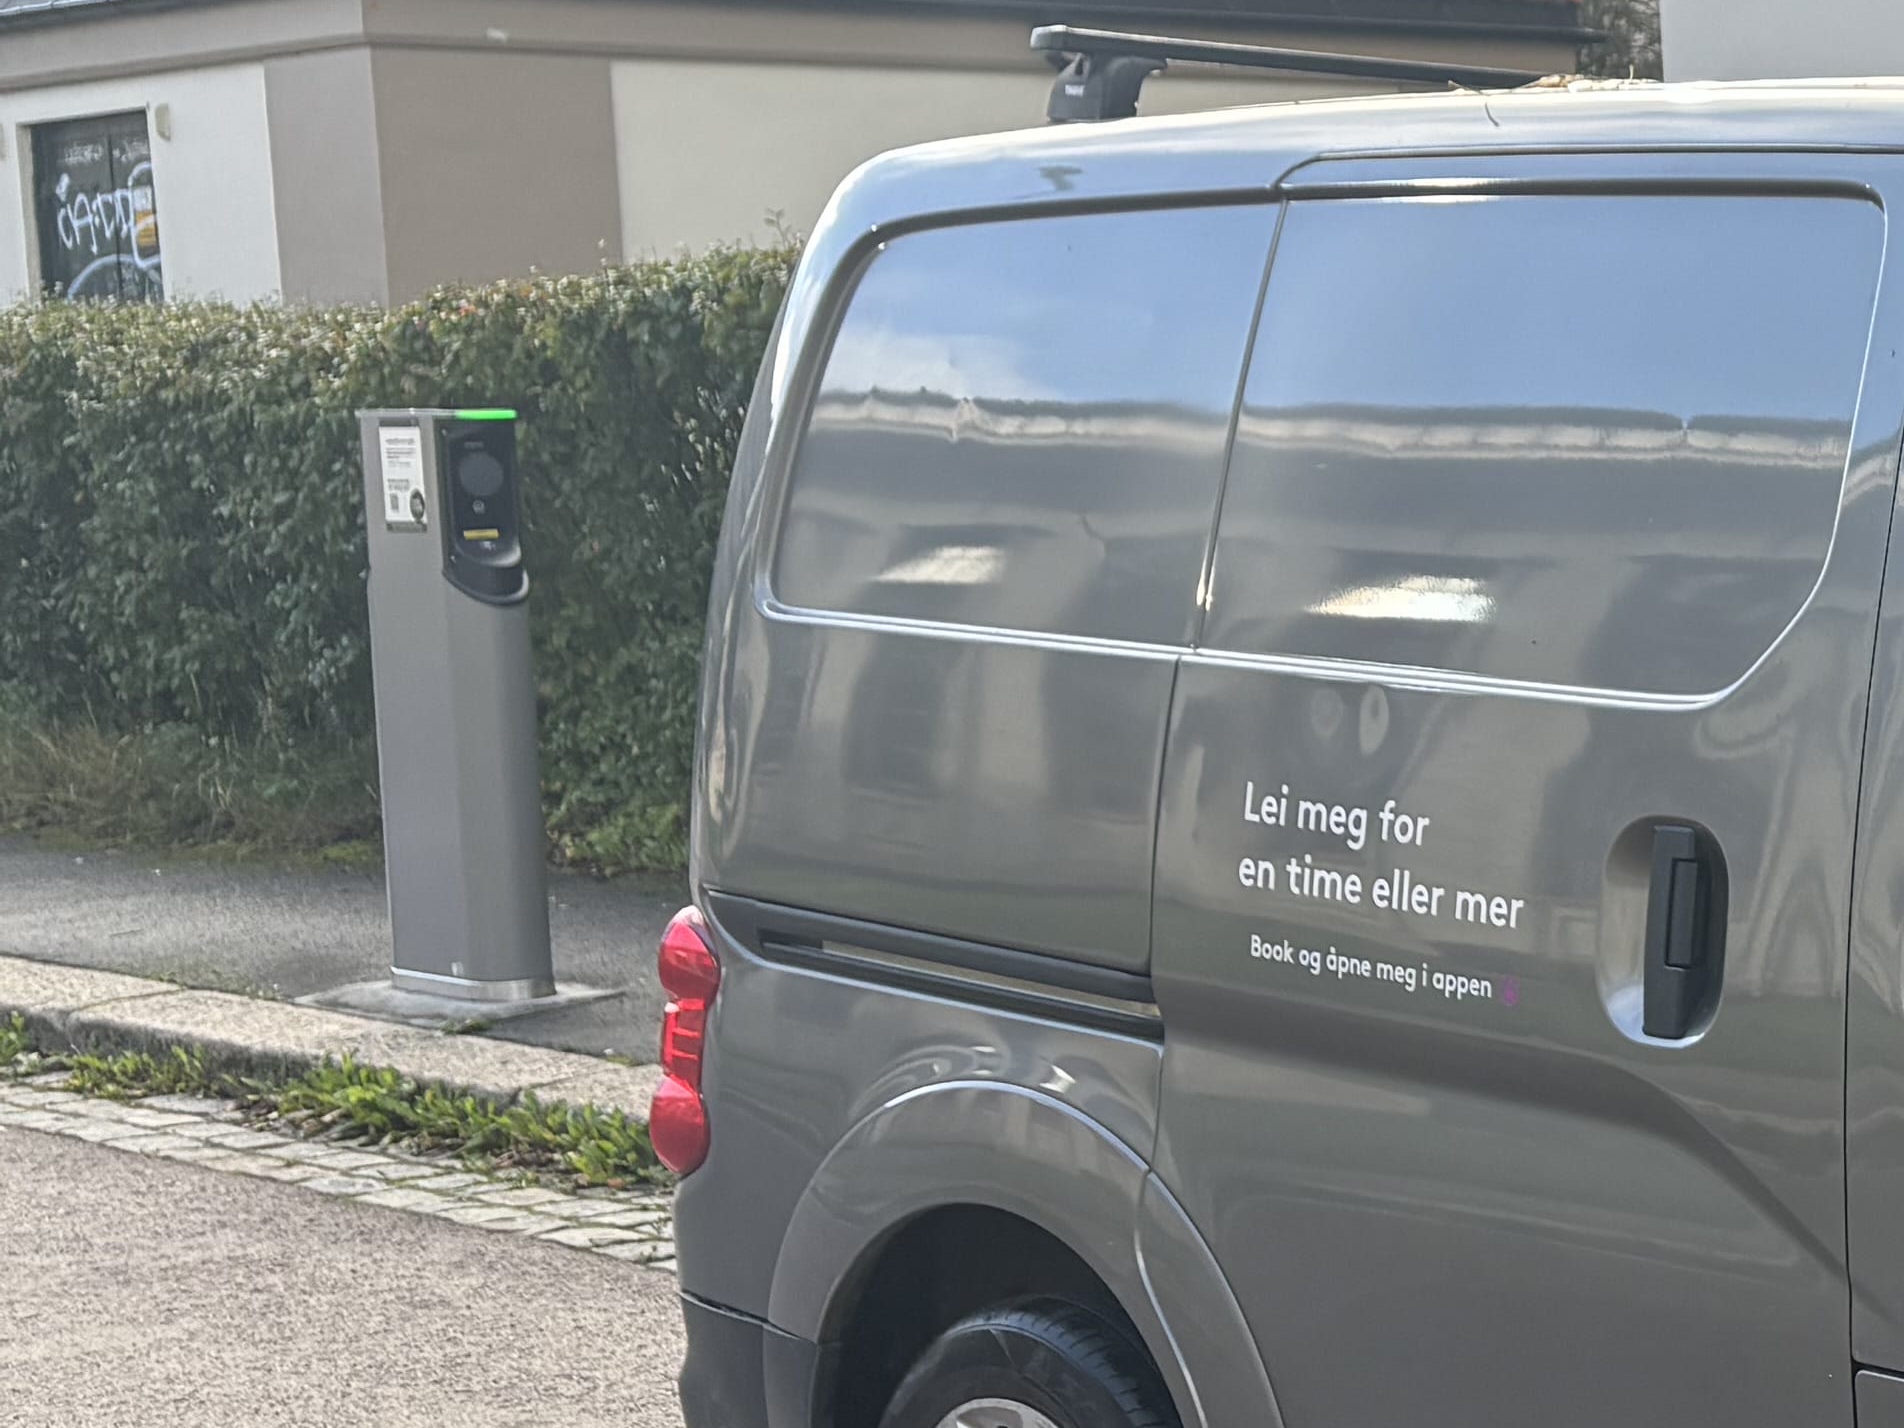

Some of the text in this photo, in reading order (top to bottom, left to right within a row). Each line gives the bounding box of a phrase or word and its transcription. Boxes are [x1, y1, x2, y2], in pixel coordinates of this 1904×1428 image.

[1244, 781, 1430, 851] Lei meg for
[1238, 854, 1524, 929] en time eller mer
[1250, 934, 1492, 1000] Book og åpne meg i appen
